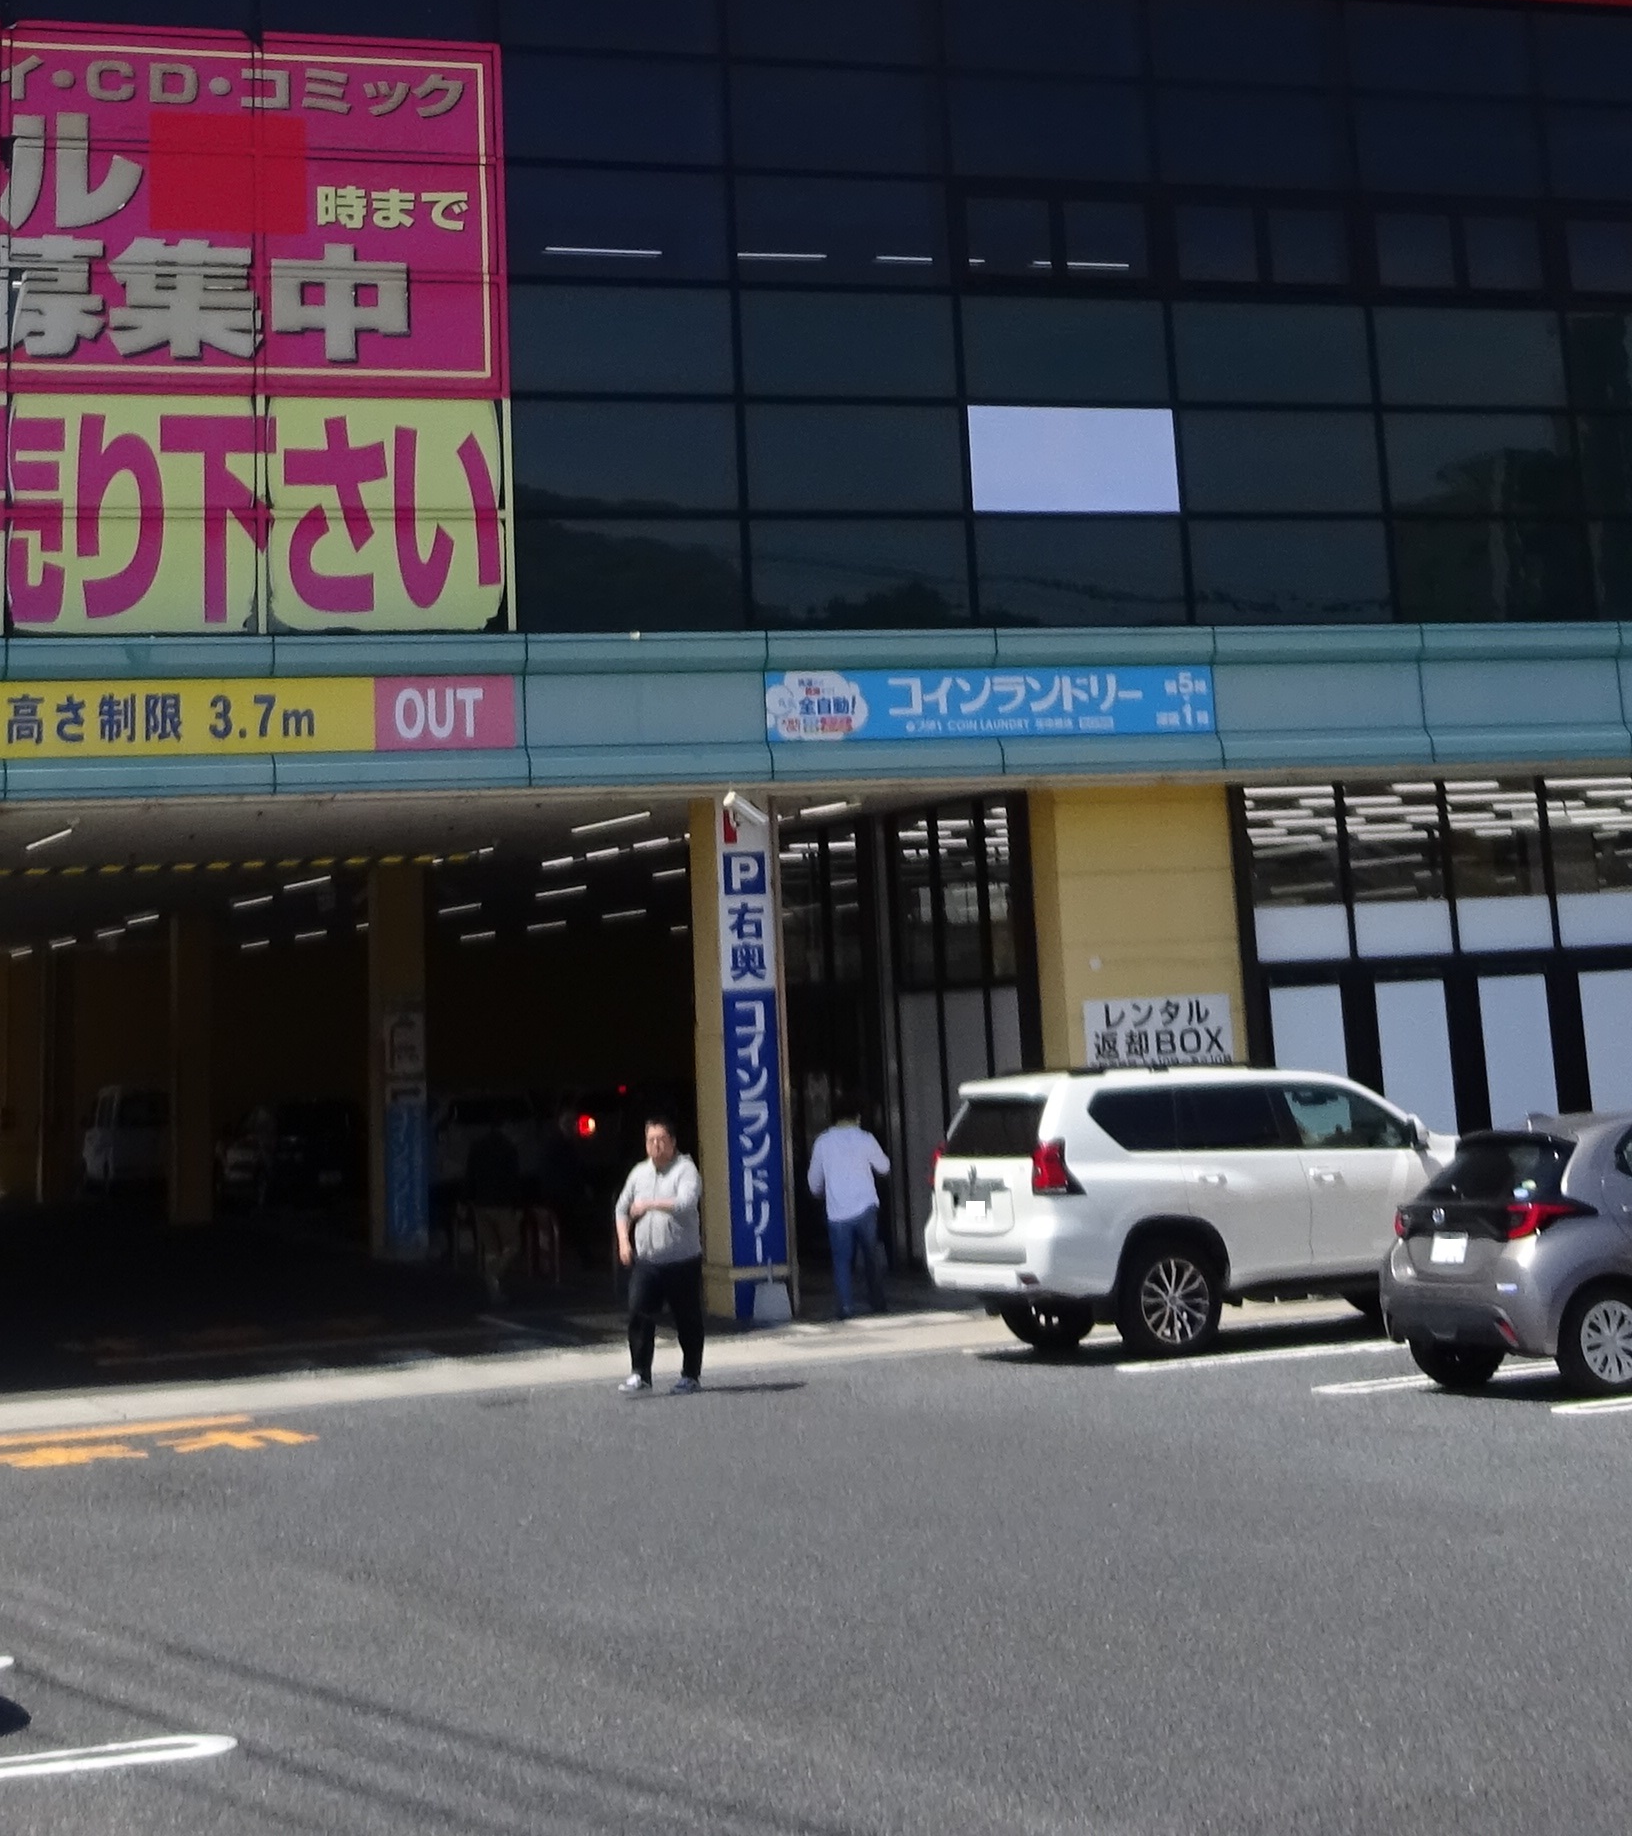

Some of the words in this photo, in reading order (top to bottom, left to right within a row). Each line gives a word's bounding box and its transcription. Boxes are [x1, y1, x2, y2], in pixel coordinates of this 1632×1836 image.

[315, 182, 468, 234] 時まで
[5, 693, 183, 746] 高さ制限
[208, 693, 316, 741] 3.7m
[394, 687, 485, 741] OUT
[887, 673, 1143, 716] コインランドリー
[730, 855, 759, 892] P
[727, 901, 767, 982] 右奥
[1103, 997, 1210, 1029] レンタル
[734, 999, 771, 1264] コインランドリー
